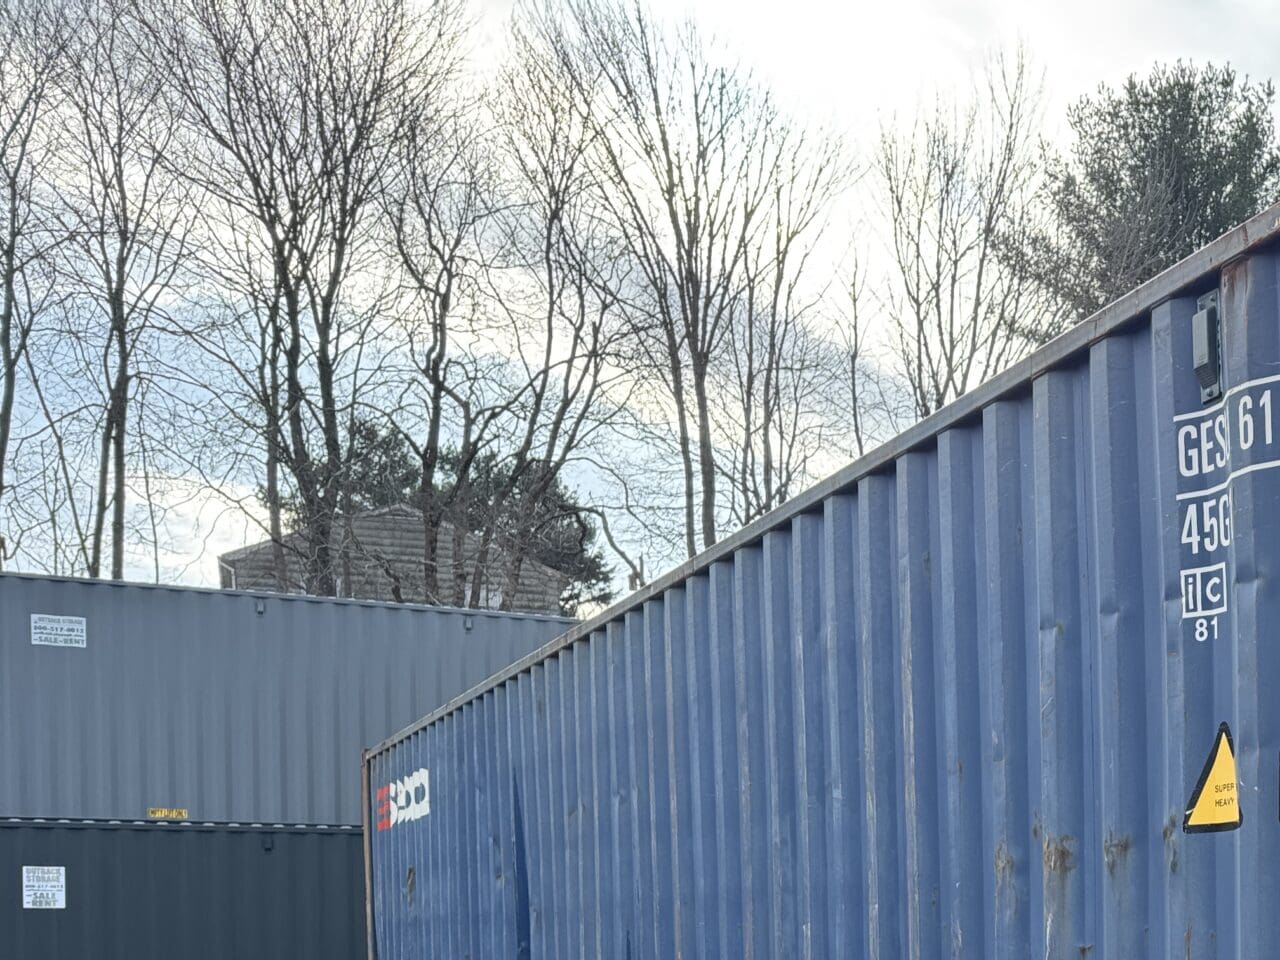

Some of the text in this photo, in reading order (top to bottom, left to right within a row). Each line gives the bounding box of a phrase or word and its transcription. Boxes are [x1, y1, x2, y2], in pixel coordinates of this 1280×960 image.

[1194, 616, 1219, 641] 81
[1214, 782, 1235, 793] SUPER
[1214, 797, 1235, 807] HEAVY
